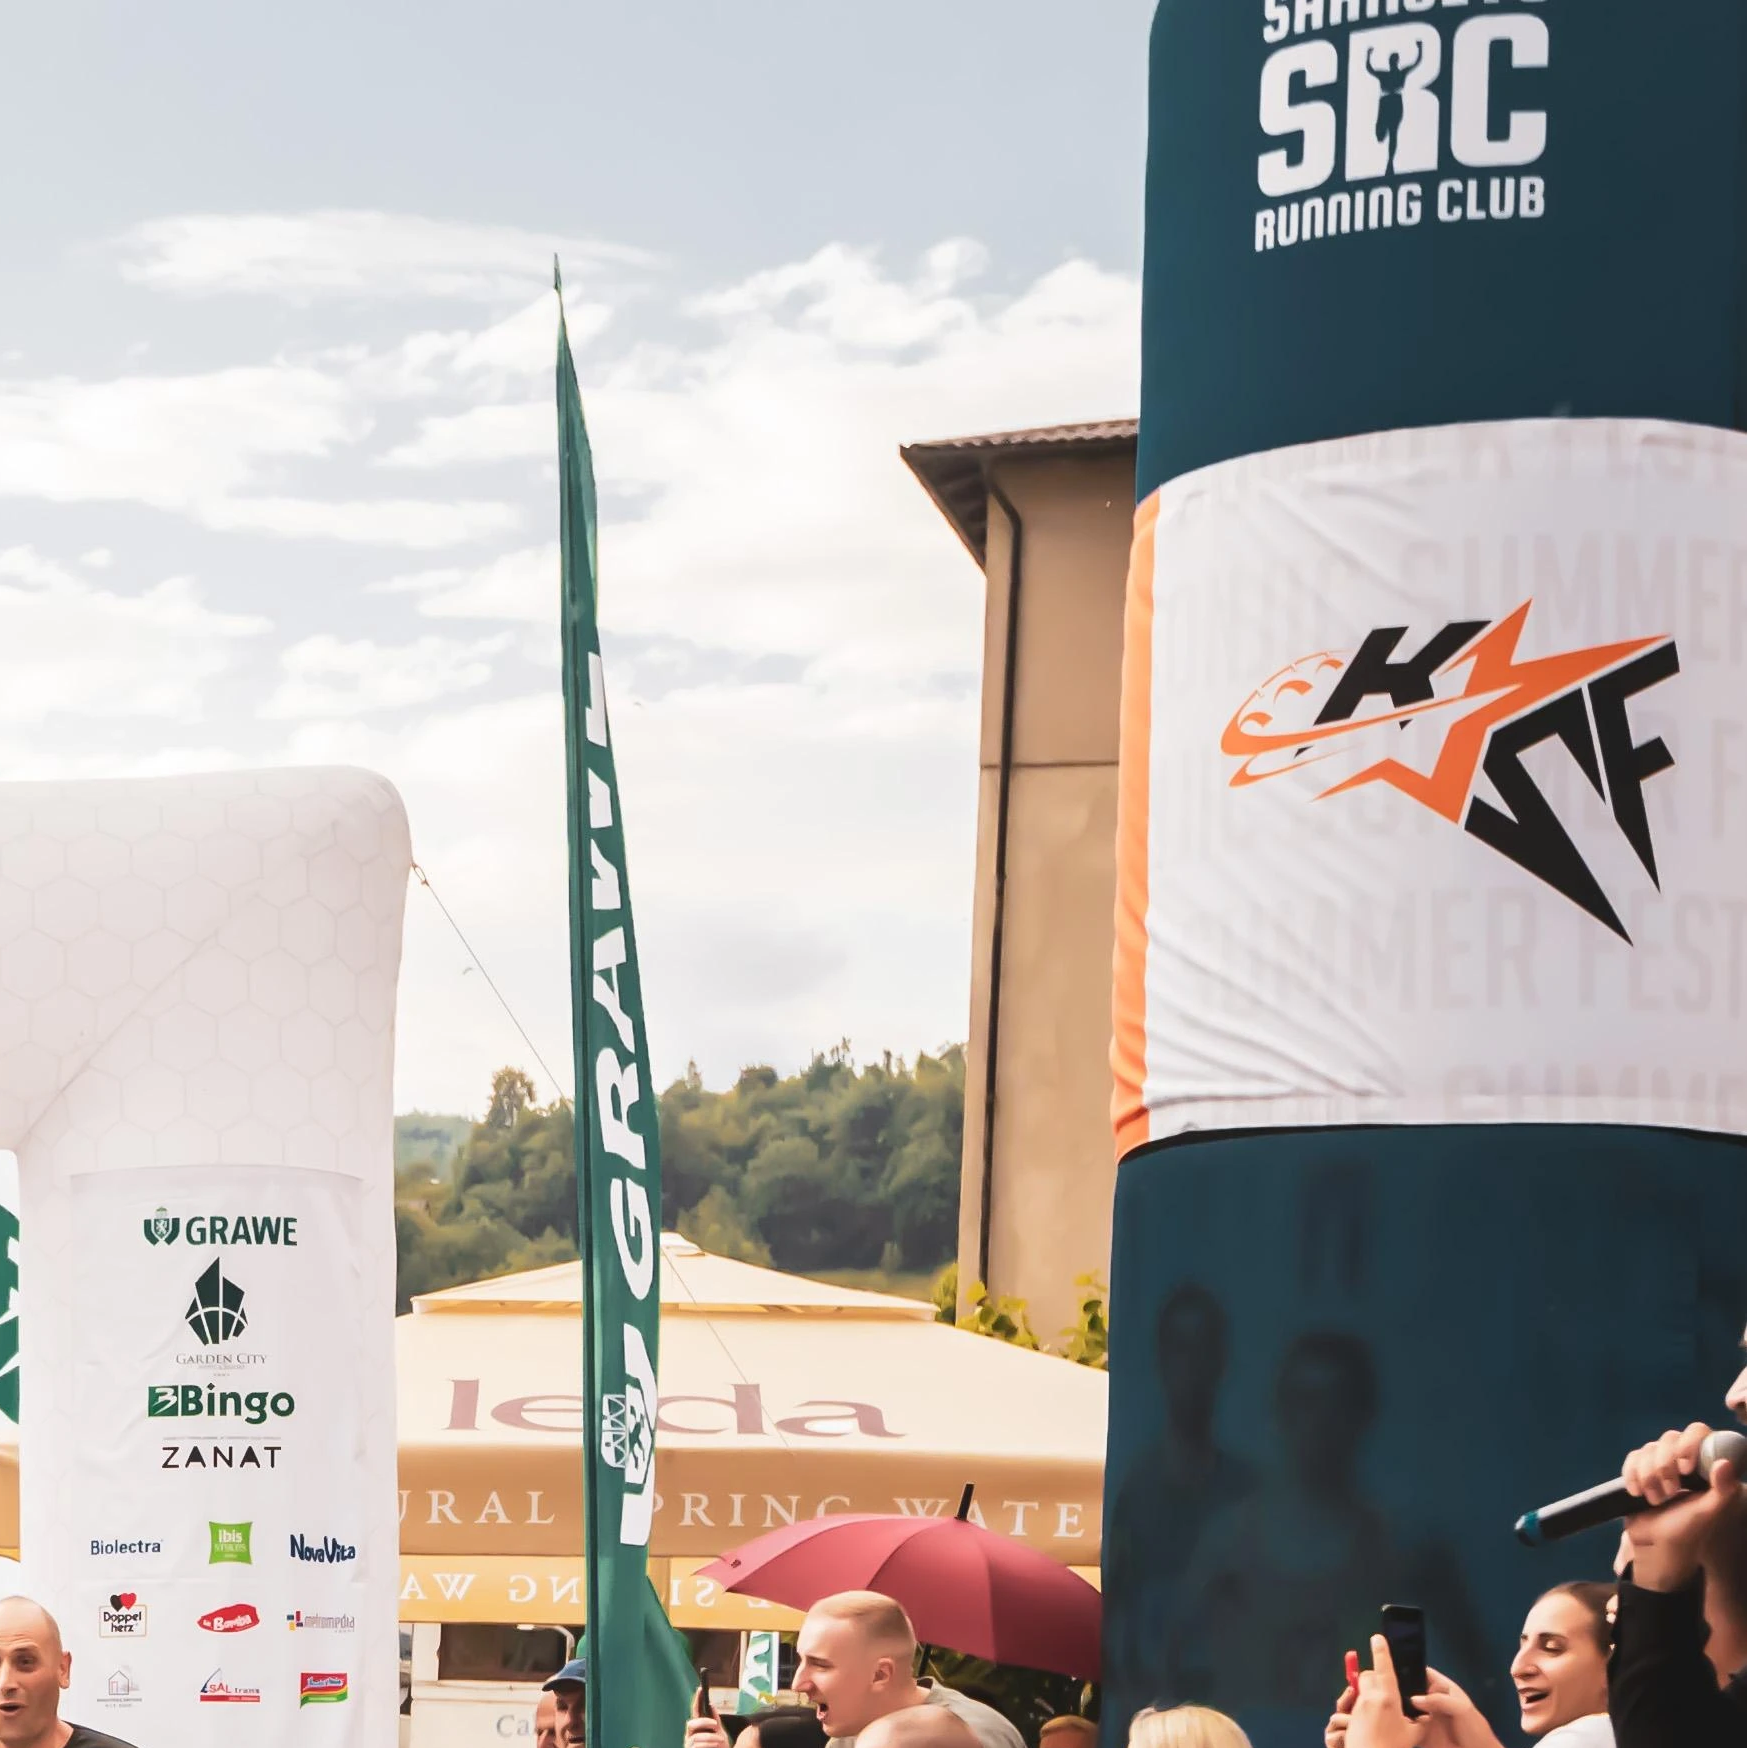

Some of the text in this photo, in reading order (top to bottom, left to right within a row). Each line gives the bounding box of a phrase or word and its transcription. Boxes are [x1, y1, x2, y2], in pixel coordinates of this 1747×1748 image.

[1254, 175, 1546, 253] RUNNING CLUB
[185, 1216, 298, 1246] GRAWE
[180, 1382, 296, 1425] Bingo
[161, 1446, 283, 1469] ZANAT
[90, 1539, 162, 1556] Biolectra
[290, 1533, 356, 1564] NovaVita
[103, 1610, 142, 1624] Doppel
[110, 1622, 135, 1633] herz
